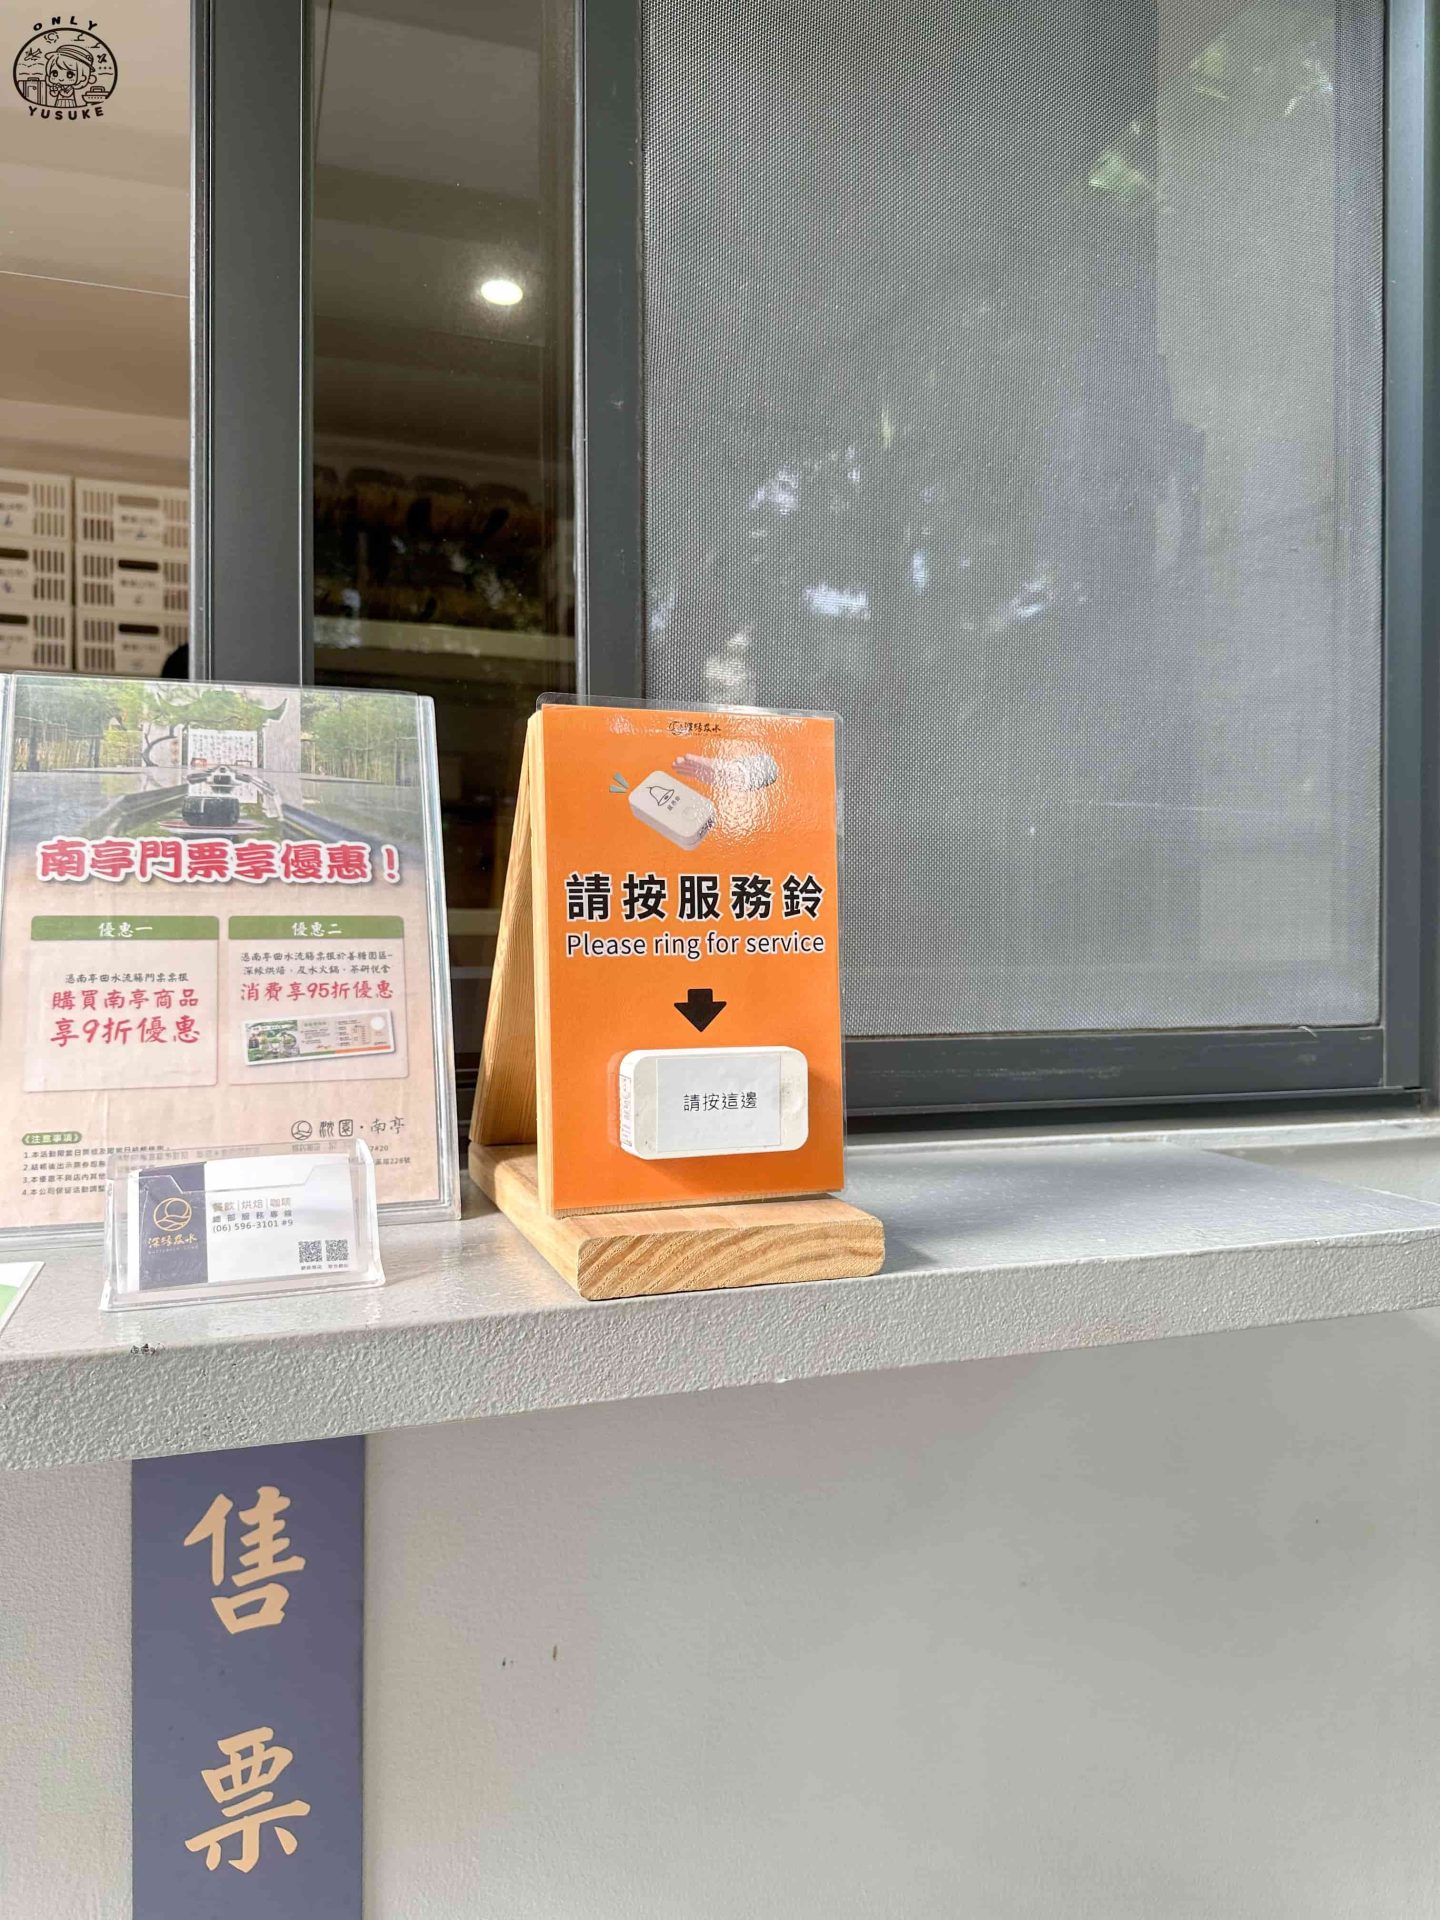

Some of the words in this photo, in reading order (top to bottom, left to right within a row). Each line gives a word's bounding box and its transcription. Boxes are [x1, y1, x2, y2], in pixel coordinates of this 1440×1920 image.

[565, 873, 824, 921] 請按服務鈴
[98, 922, 153, 938] 優惠一
[292, 922, 343, 937] 優惠二
[567, 935, 646, 955] Please
[655, 934, 699, 959] ring
[707, 932, 739, 953] for
[746, 932, 824, 953] service
[52, 988, 199, 1010] 購買南亭商品
[240, 980, 394, 1002] 消費享95折優惠
[50, 1015, 200, 1047] 享9折優惠
[683, 1091, 757, 1112] 請按這邊
[212, 1223, 232, 1233] (06)
[234, 1220, 279, 1231] 596-3101
[183, 1486, 311, 1873] 售票
